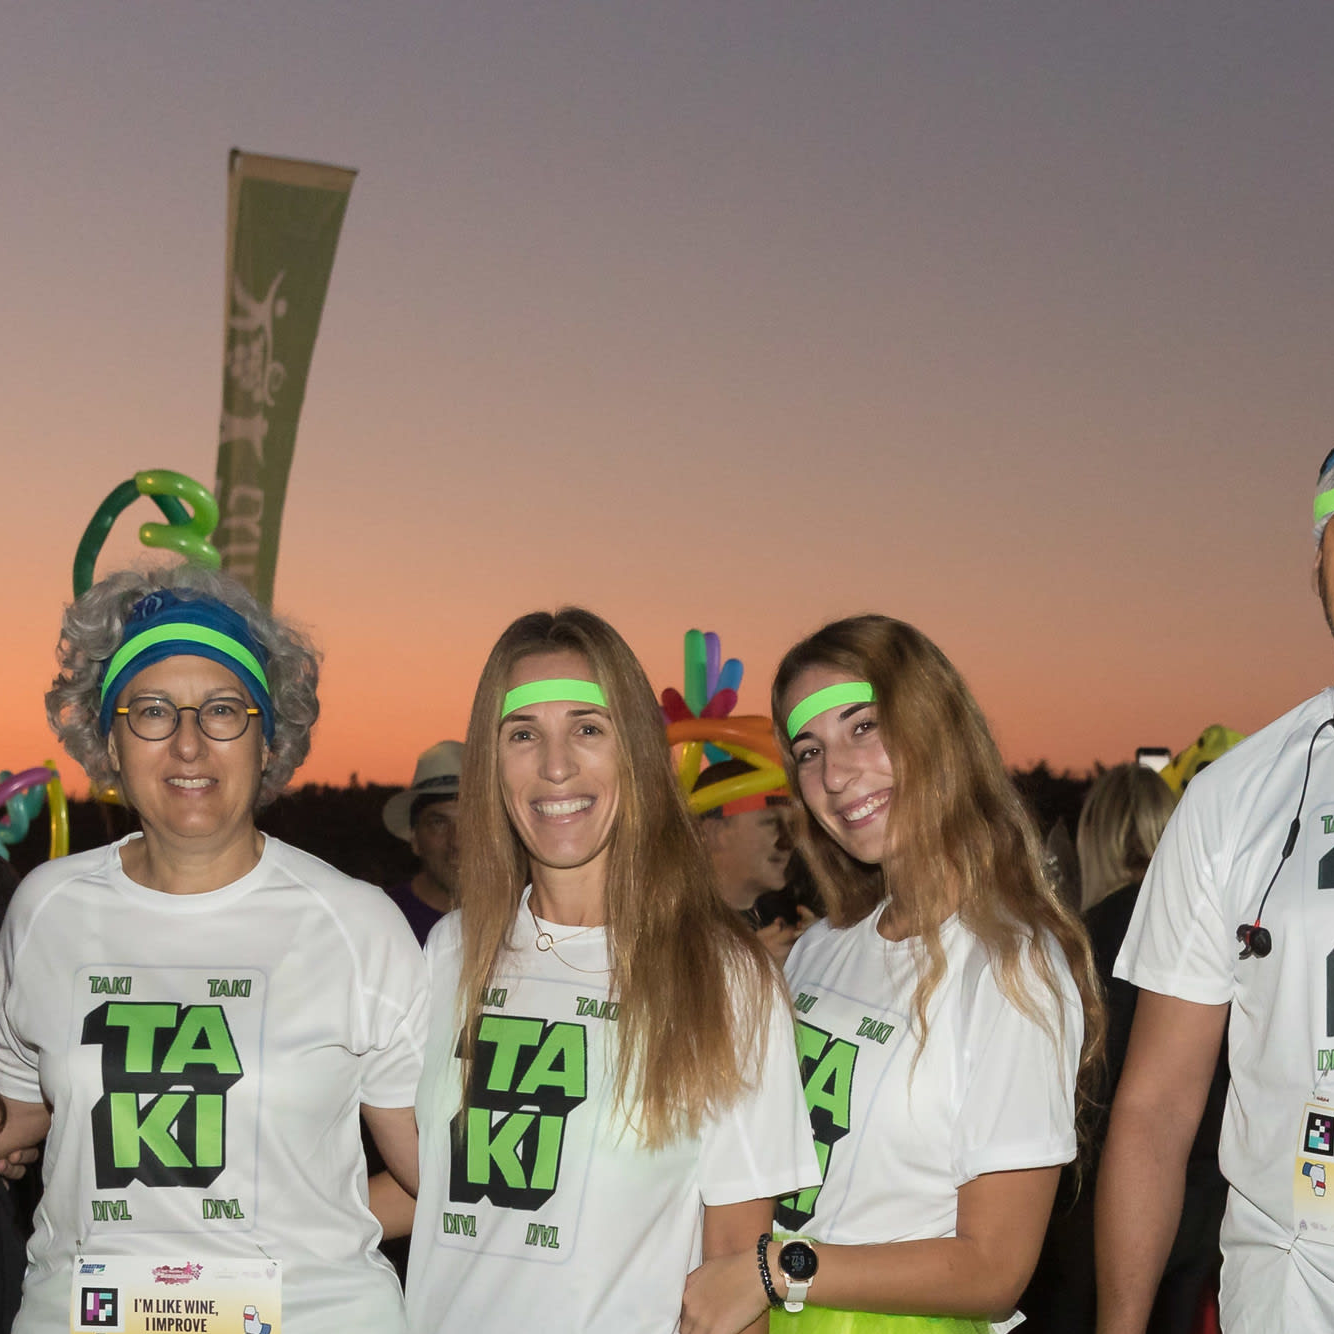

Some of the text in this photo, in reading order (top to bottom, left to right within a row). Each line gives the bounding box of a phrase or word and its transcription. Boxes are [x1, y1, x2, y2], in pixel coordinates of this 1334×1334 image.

[89, 976, 132, 995] TAKI
[208, 979, 251, 997] TAKI
[481, 988, 507, 1008] AKI
[81, 1001, 244, 1080] TA
[856, 1017, 895, 1045] TAKI
[460, 1013, 587, 1100] TA
[91, 1091, 226, 1178] KI
[450, 1107, 566, 1197] KI
[92, 1200, 132, 1221] TAKI
[203, 1199, 244, 1220] TAKI
[444, 1213, 477, 1237] TAKI
[525, 1223, 559, 1248] TAKI
[134, 1299, 219, 1316] I'M LIKE WINE,
[145, 1317, 207, 1333] I IMPROVE
